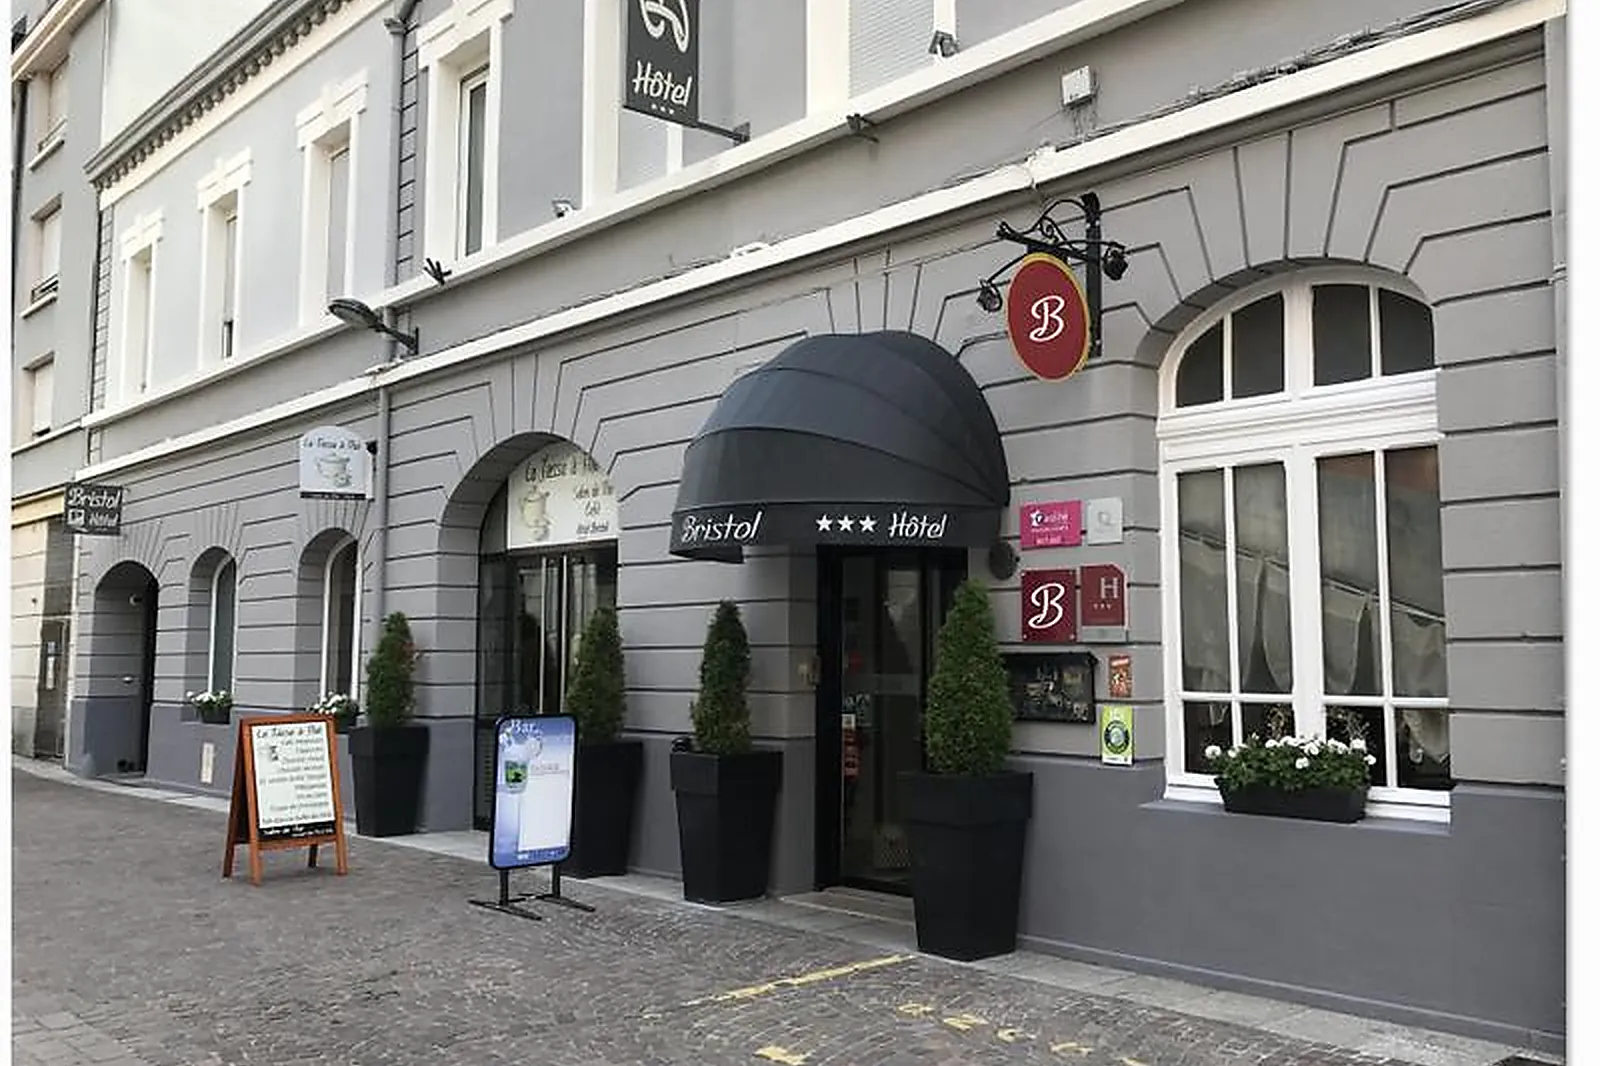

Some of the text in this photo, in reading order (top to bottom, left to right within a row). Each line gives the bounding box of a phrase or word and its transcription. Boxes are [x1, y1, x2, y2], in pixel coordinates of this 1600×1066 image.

[632, 60, 693, 106] Hôtel
[1029, 295, 1065, 343] B
[68, 487, 121, 509] Bristol
[681, 511, 947, 543] Bristol Hôtel
[1028, 583, 1065, 629] B
[1101, 577, 1118, 599] H
